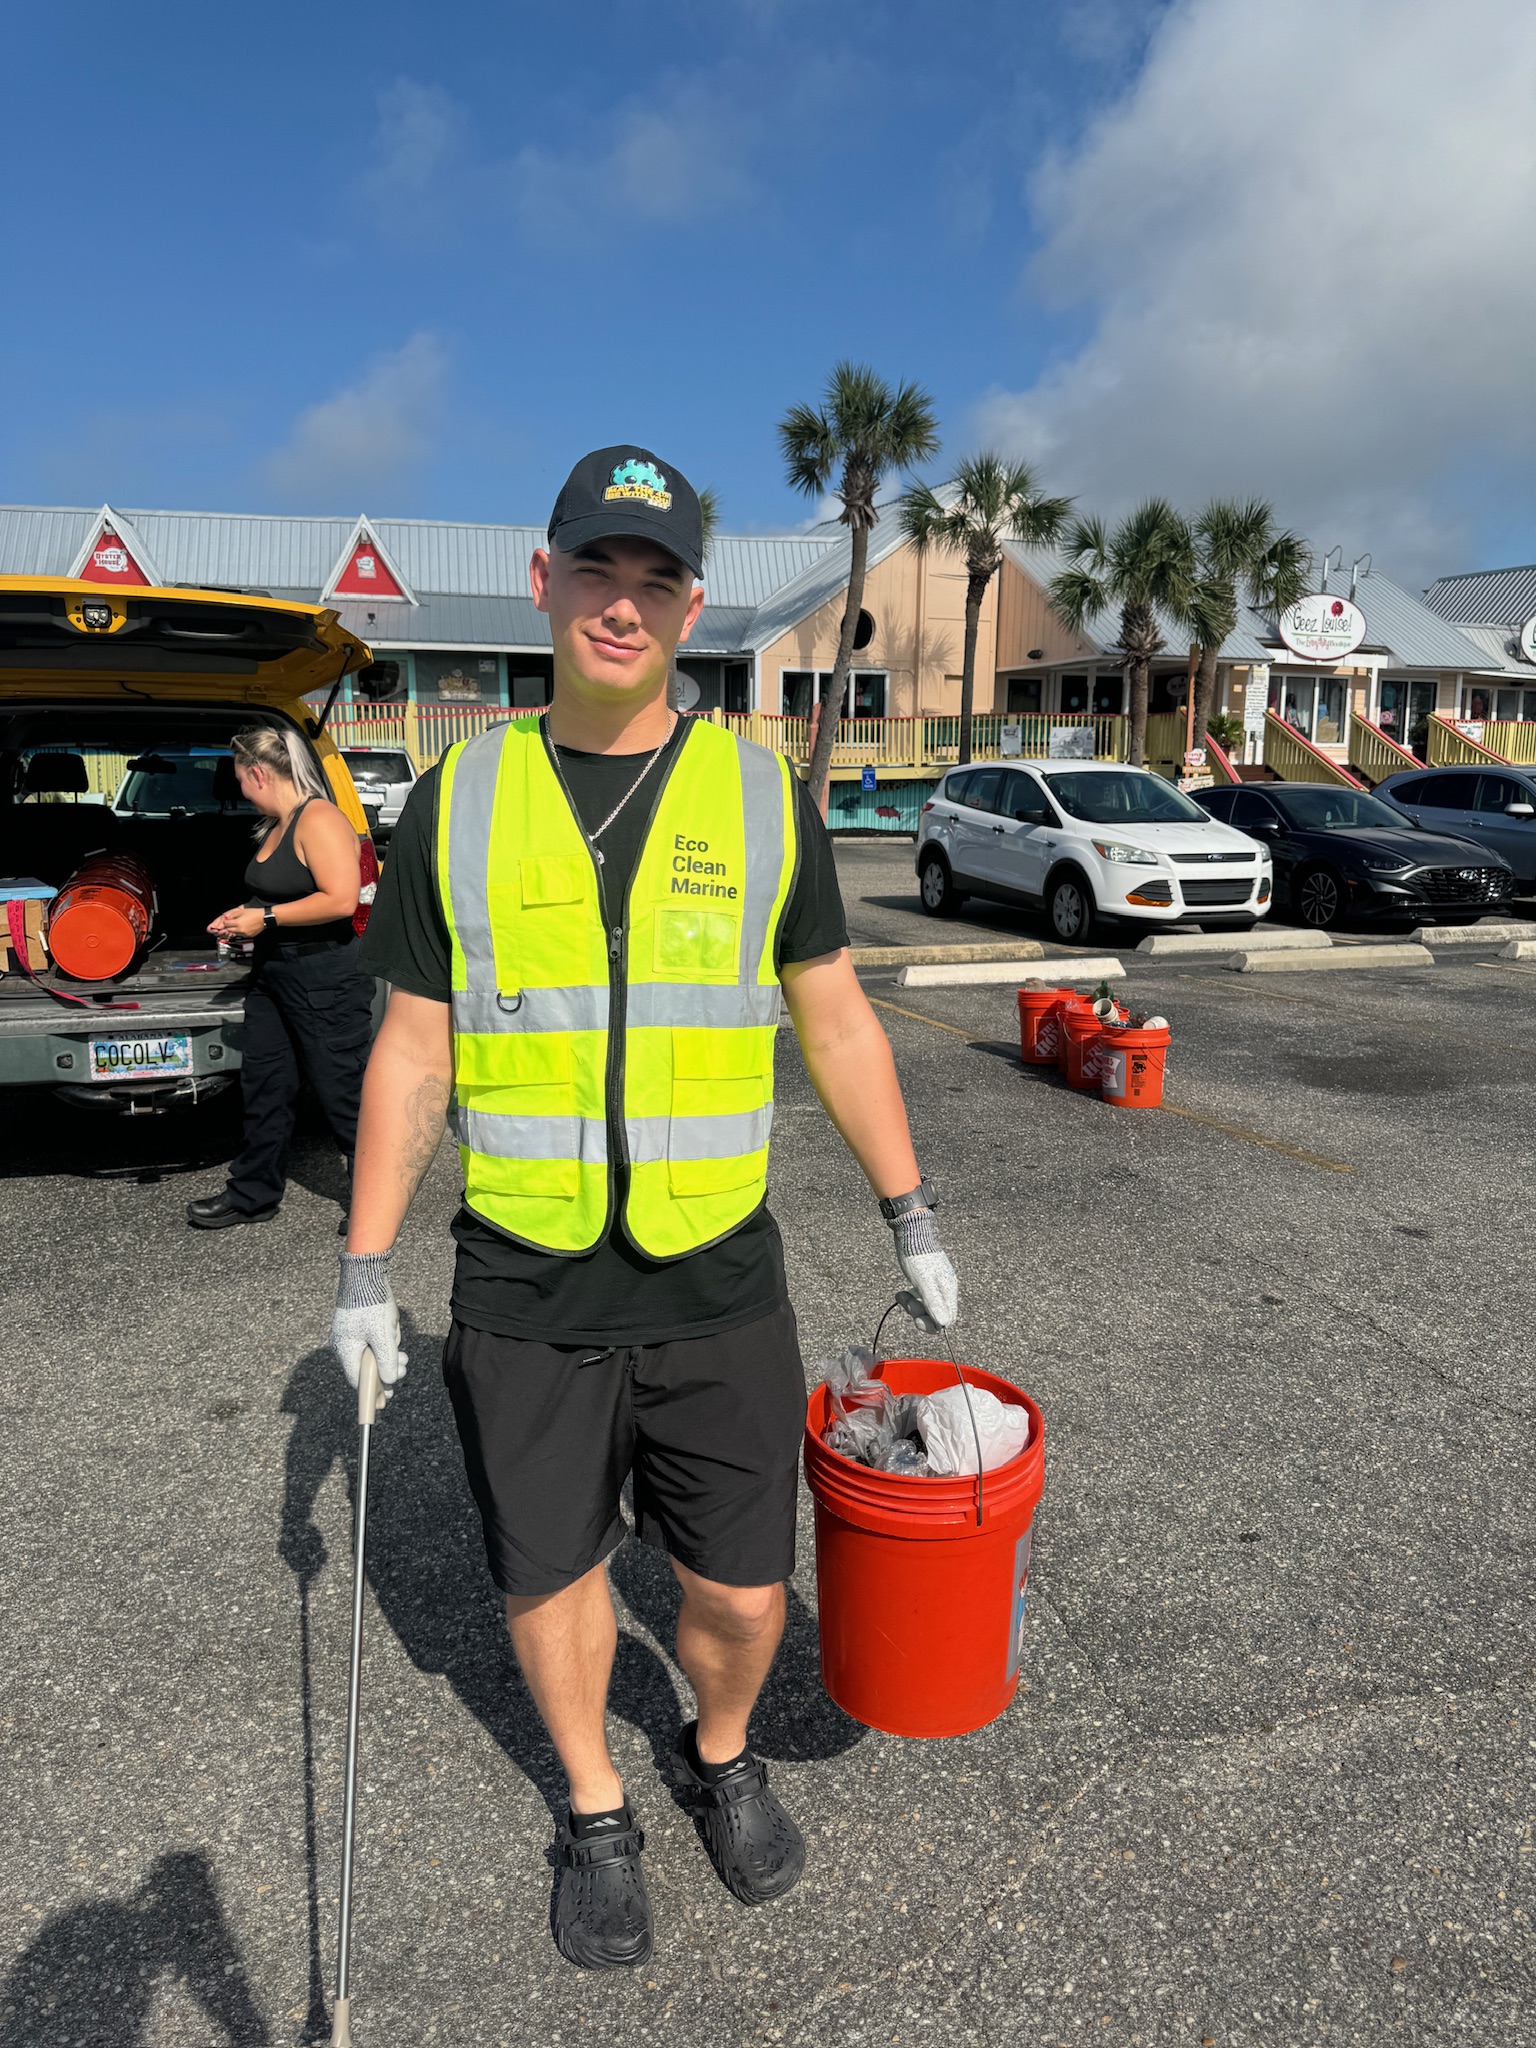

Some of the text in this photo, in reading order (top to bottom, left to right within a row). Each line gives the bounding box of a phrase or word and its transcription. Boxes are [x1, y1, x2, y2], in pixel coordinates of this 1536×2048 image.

[1293, 606, 1353, 633] Geez Louise!
[674, 834, 709, 853] Eco
[672, 855, 727, 876] Clean
[671, 877, 738, 899] Marine
[119, 1033, 163, 1041] ALABAMA
